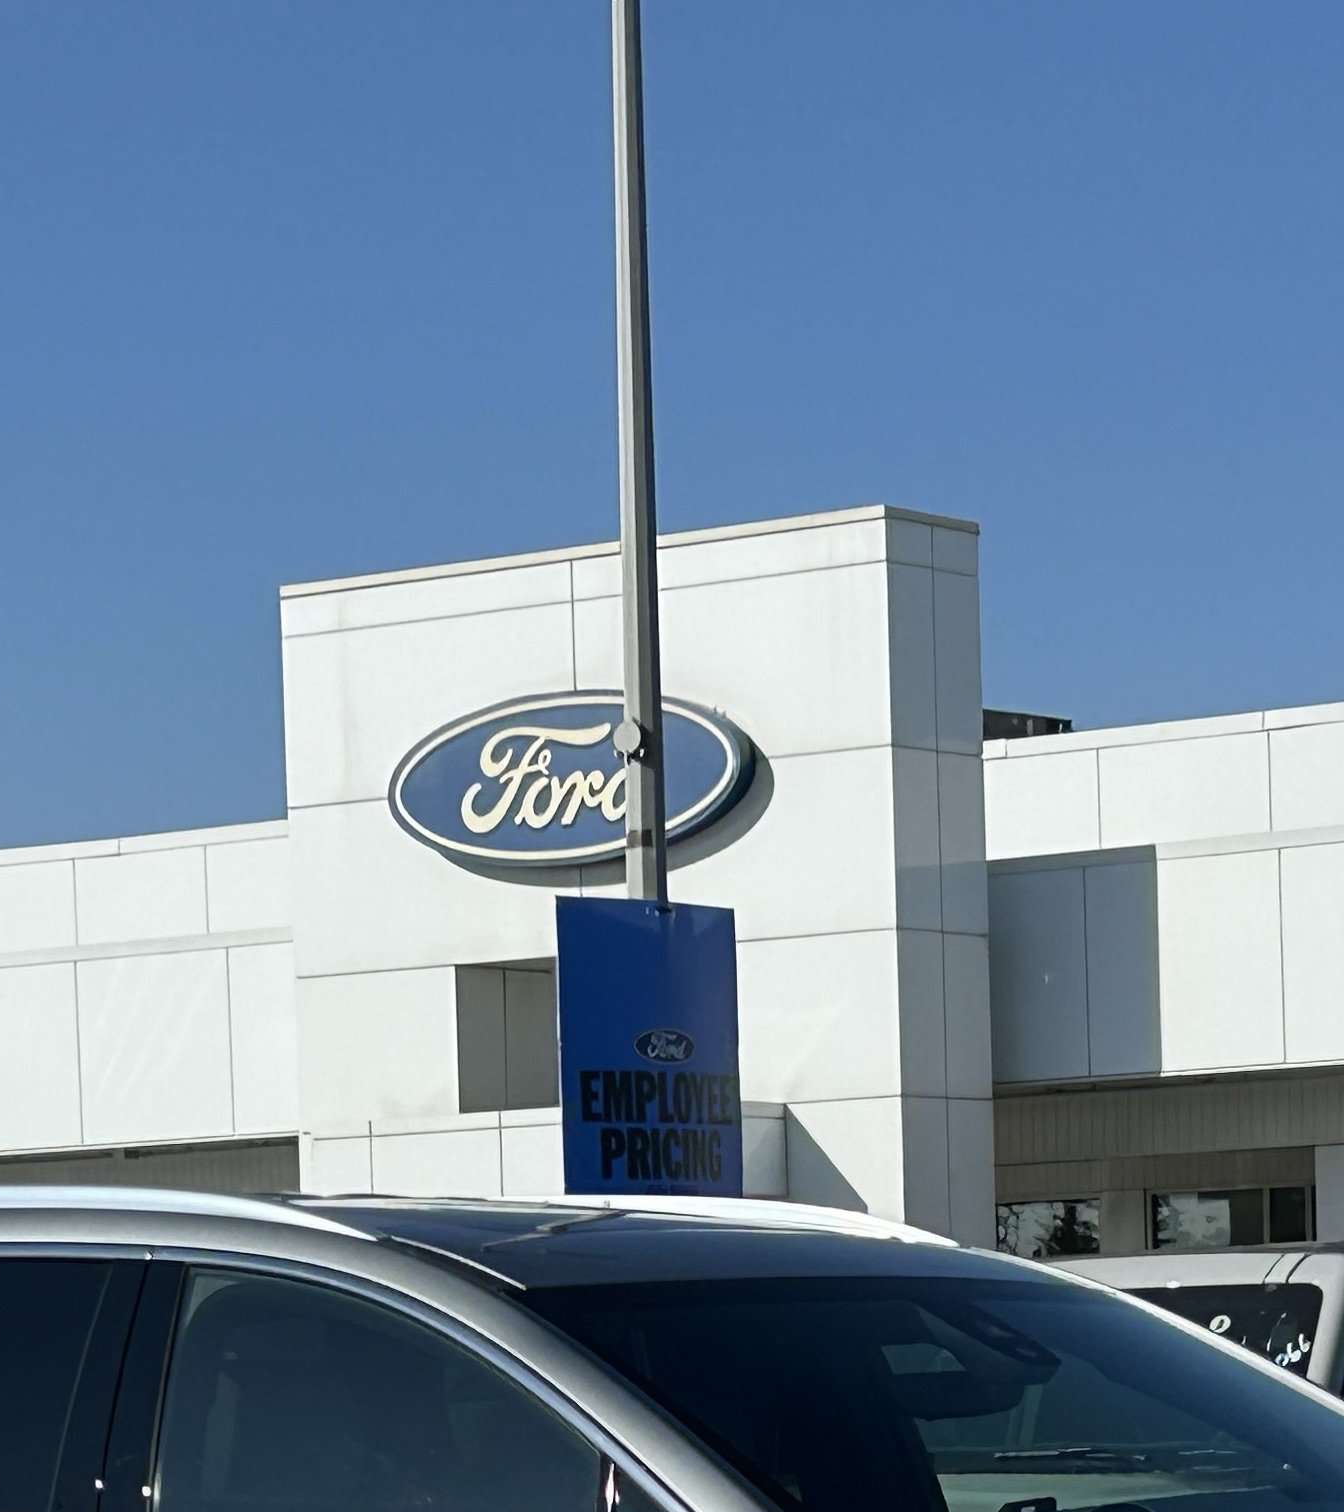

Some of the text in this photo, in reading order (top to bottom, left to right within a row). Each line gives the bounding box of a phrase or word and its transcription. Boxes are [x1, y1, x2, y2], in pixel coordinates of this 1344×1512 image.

[647, 1033, 688, 1060] Ford
[579, 1069, 734, 1125] EMPLOYEE
[601, 1127, 722, 1182] PRICING
